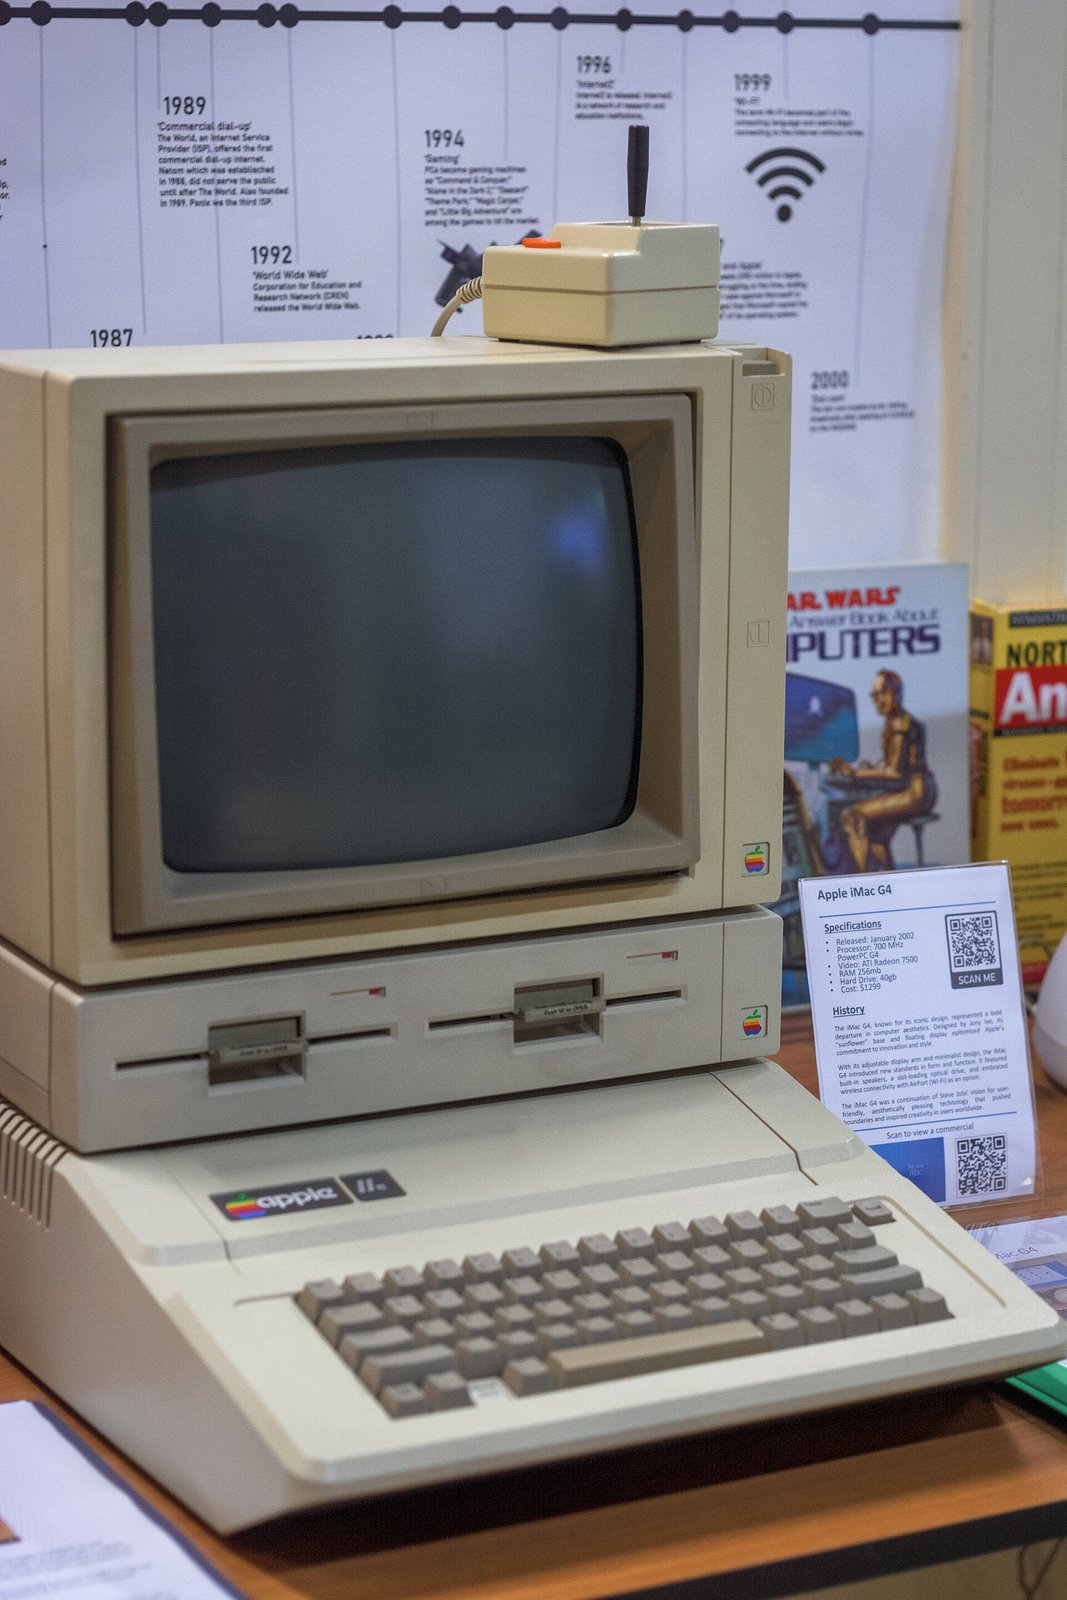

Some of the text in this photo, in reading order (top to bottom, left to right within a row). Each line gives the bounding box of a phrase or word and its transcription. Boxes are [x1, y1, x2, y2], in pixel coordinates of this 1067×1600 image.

[577, 56, 612, 73] 1996
[734, 74, 772, 92] 1999
[163, 96, 206, 115] 1989
[424, 130, 464, 148] 1994
[251, 246, 292, 264] 1992
[90, 328, 133, 348] 1987
[787, 586, 900, 611] AR WARS
[786, 624, 940, 663] PUTERS
[818, 885, 892, 902] Apple iMac G4
[824, 920, 882, 934] Specifications
[836, 936, 868, 945] Released:
[837, 945, 873, 953] Processor:
[838, 952, 868, 961] PowerPC
[858, 967, 882, 975] 256mb
[840, 977, 857, 985] Hard
[879, 973, 897, 982] 40gb
[958, 972, 996, 984] SCAN ME
[860, 983, 881, 991] $1299
[832, 1006, 865, 1016] History
[952, 1011, 982, 1021] represented
[934, 1022, 957, 1030] Designed
[836, 1047, 871, 1056] commitment
[879, 1043, 908, 1051] innovation
[862, 1060, 889, 1069] adjustable
[935, 1052, 961, 1060] minimalist
[849, 1068, 878, 1077] introduced
[893, 1064, 919, 1072] standards
[897, 1072, 928, 1080] slot-loading
[930, 1069, 948, 1078] optical
[863, 1083, 896, 1092] connectivity
[929, 1077, 946, 1086] (Wi-Fi)
[897, 1094, 930, 1103] continuation
[872, 1105, 905, 1114] aesthetically
[912, 1102, 933, 1111] pleasing
[940, 1099, 968, 1107] technology
[886, 1112, 907, 1121] inspired
[908, 1110, 933, 1118] creativity
[936, 1122, 974, 1134] commercial
[256, 1187, 338, 1210] apple
